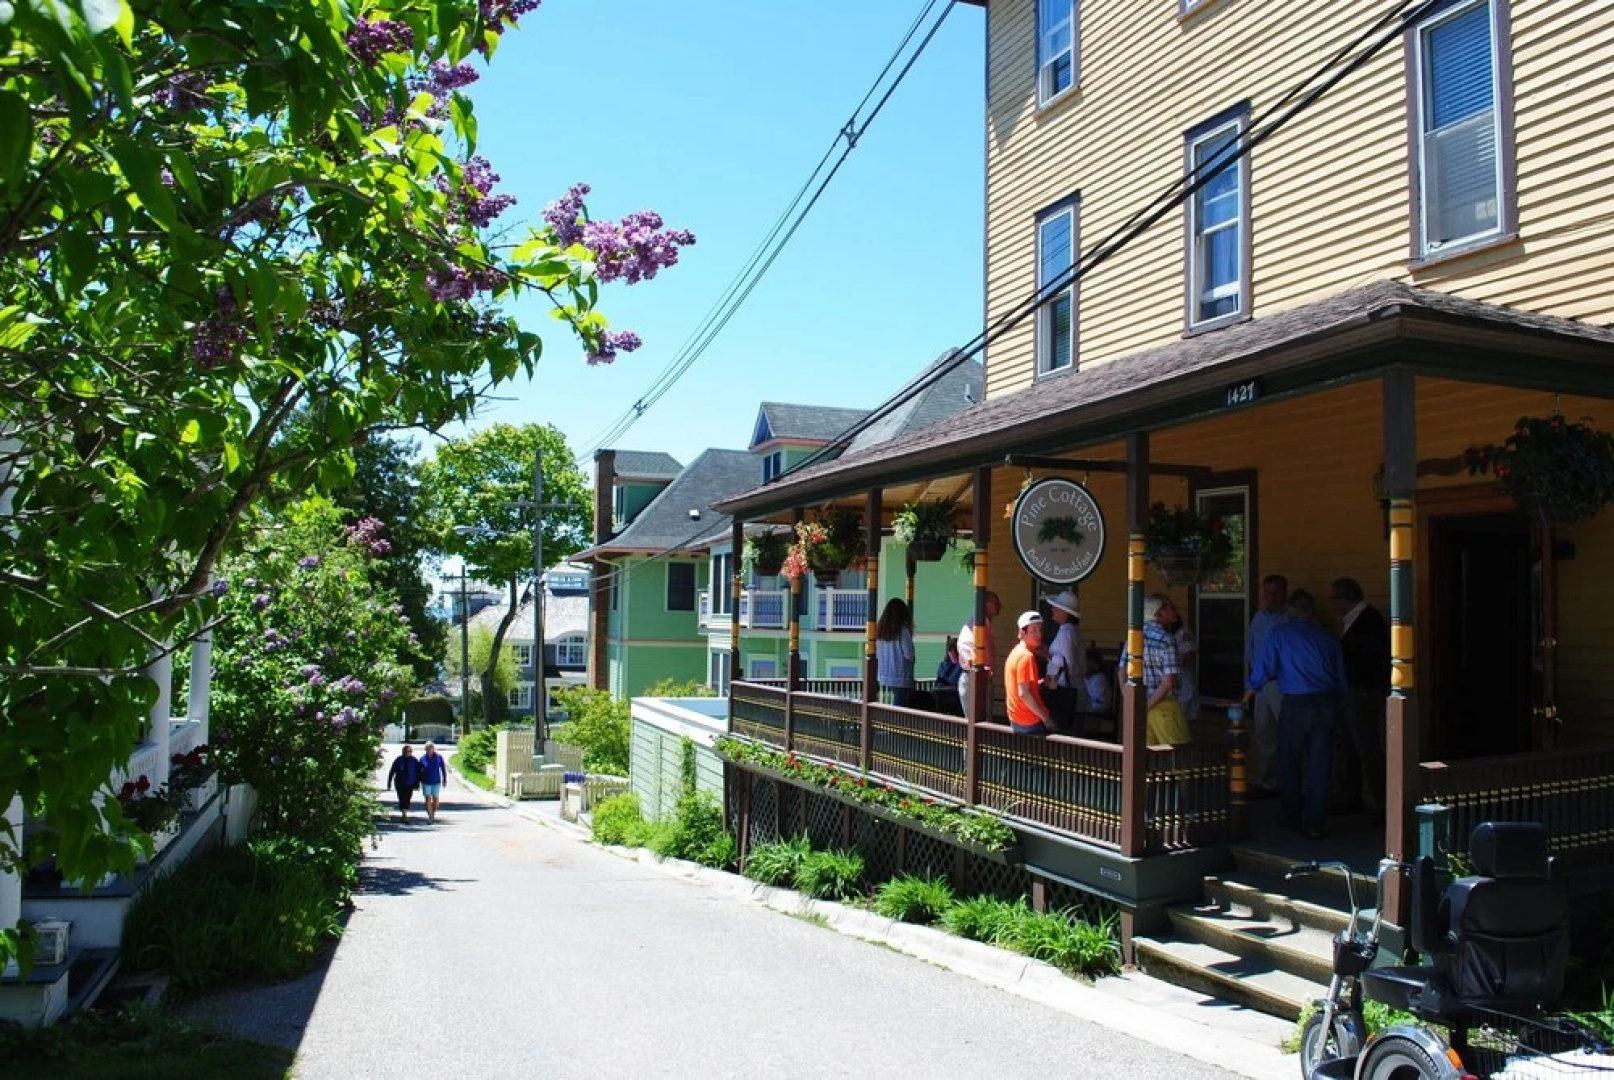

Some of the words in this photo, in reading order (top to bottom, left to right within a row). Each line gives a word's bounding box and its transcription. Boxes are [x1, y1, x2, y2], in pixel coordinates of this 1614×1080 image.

[1227, 381, 1255, 405] 1427
[1021, 496, 1047, 527] Pine
[1048, 486, 1097, 532] Cottage
[1026, 548, 1047, 567] Bed
[1043, 562, 1052, 573] &
[1053, 551, 1094, 576] Breakfast
